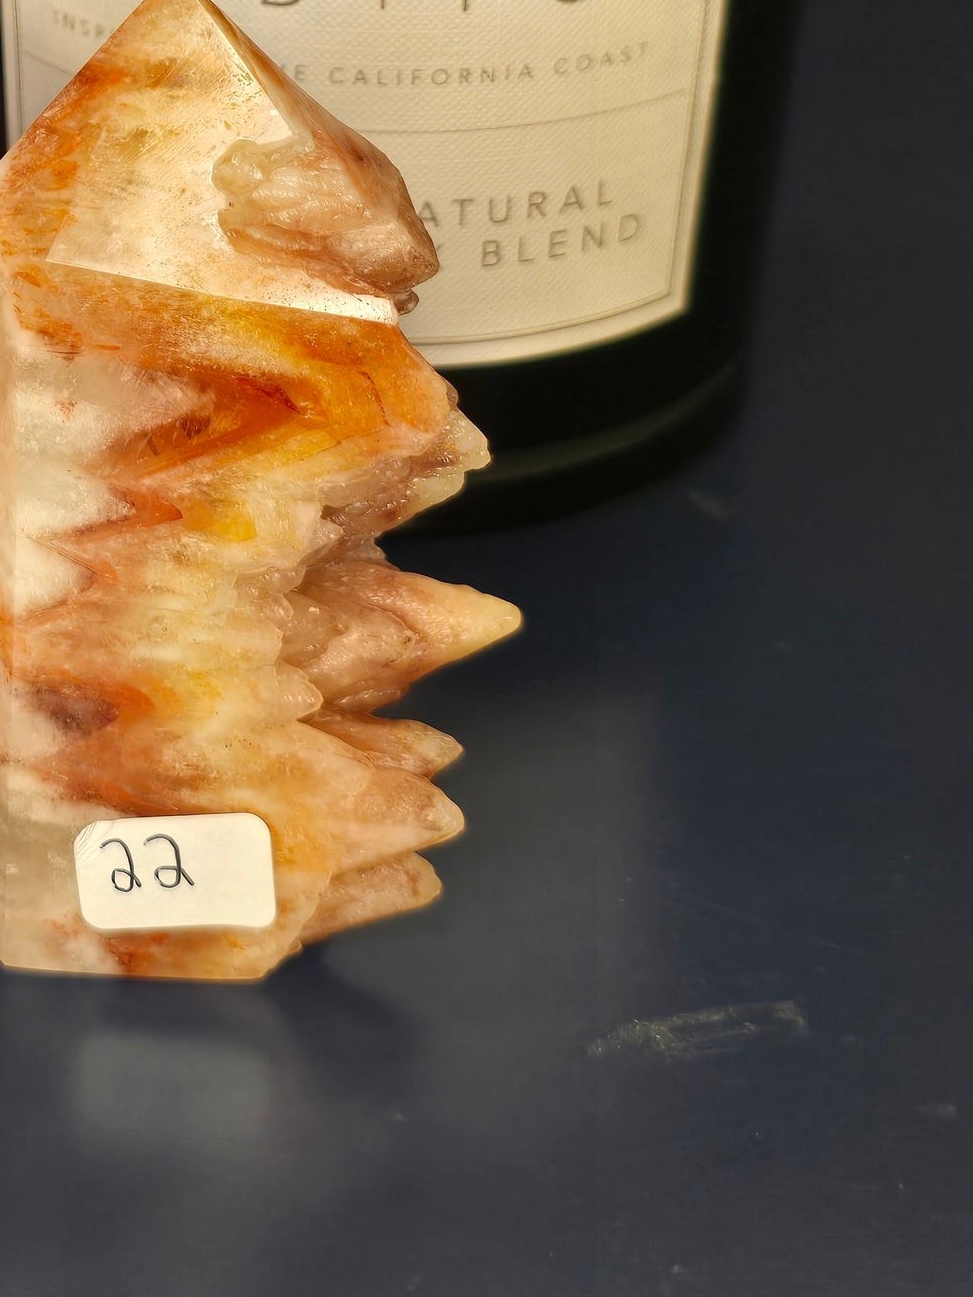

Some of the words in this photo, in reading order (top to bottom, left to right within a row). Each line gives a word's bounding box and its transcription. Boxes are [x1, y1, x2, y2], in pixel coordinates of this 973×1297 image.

[328, 63, 535, 87] CALIFORNIA
[552, 41, 651, 77] COAST
[416, 179, 613, 228] ATURAL
[481, 213, 642, 268] BLEND
[99, 832, 196, 894] 22
